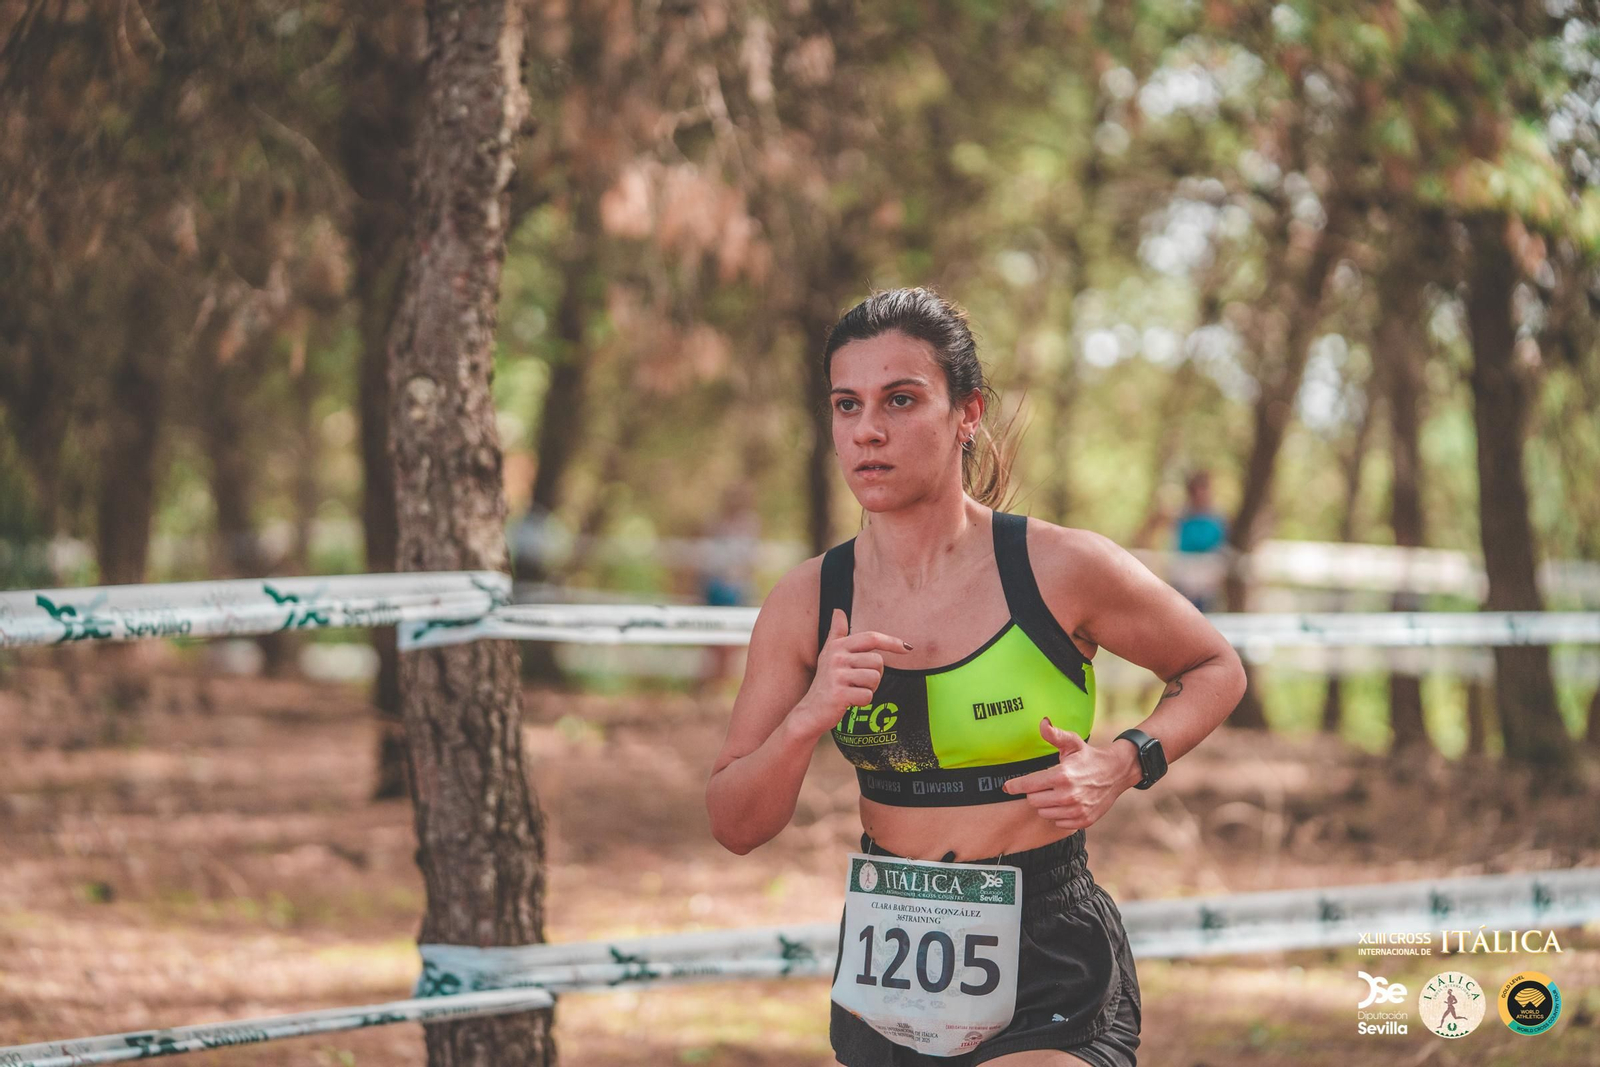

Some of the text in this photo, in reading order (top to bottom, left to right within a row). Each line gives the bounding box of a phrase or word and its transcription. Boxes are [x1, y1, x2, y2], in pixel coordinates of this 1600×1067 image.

[885, 866, 964, 895] ITÁLICA
[871, 901, 982, 918] CLARA BARCELONA GONZÁLEZ
[896, 914, 942, 925] 365TRAINING
[856, 924, 1001, 997] 1205
